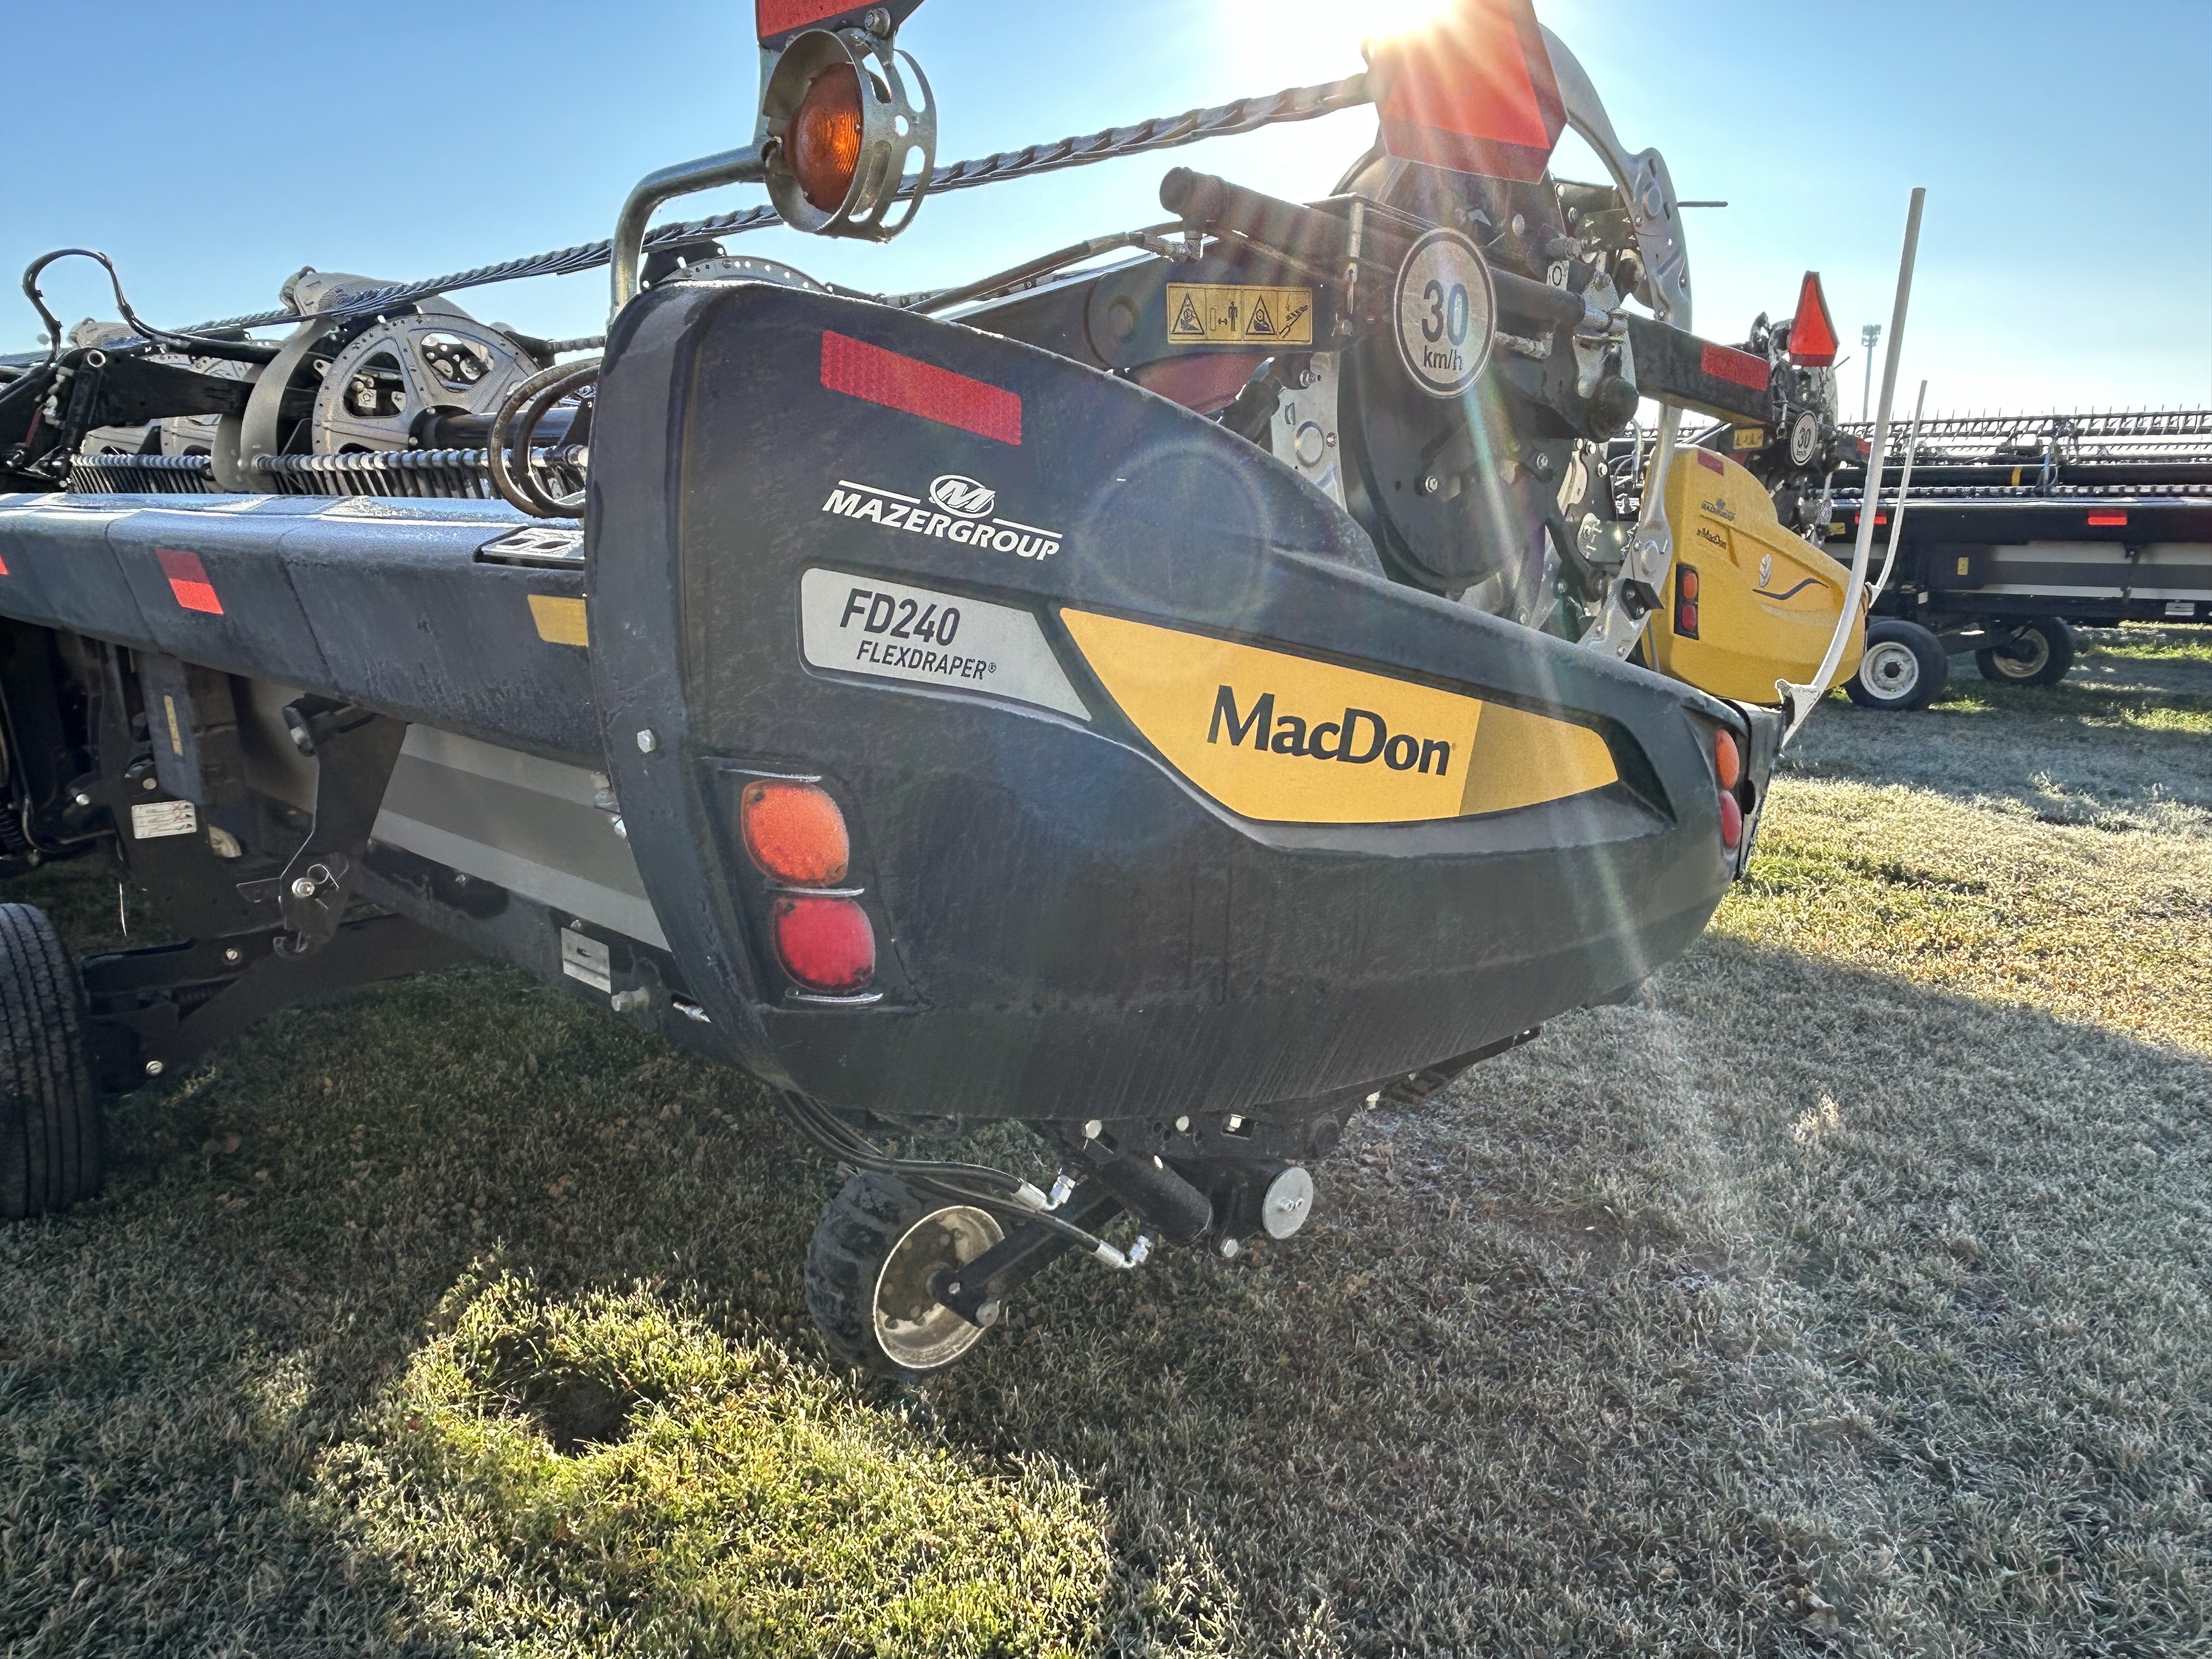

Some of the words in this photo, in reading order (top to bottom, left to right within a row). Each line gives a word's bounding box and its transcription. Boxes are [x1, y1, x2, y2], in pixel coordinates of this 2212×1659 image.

[1421, 279, 1469, 346] 30
[1423, 346, 1464, 371] km/h
[1797, 426, 1812, 449] 30
[822, 488, 1060, 561] MAZERGROUP
[840, 588, 960, 646] FD240
[1206, 684, 1451, 776] MacDon
